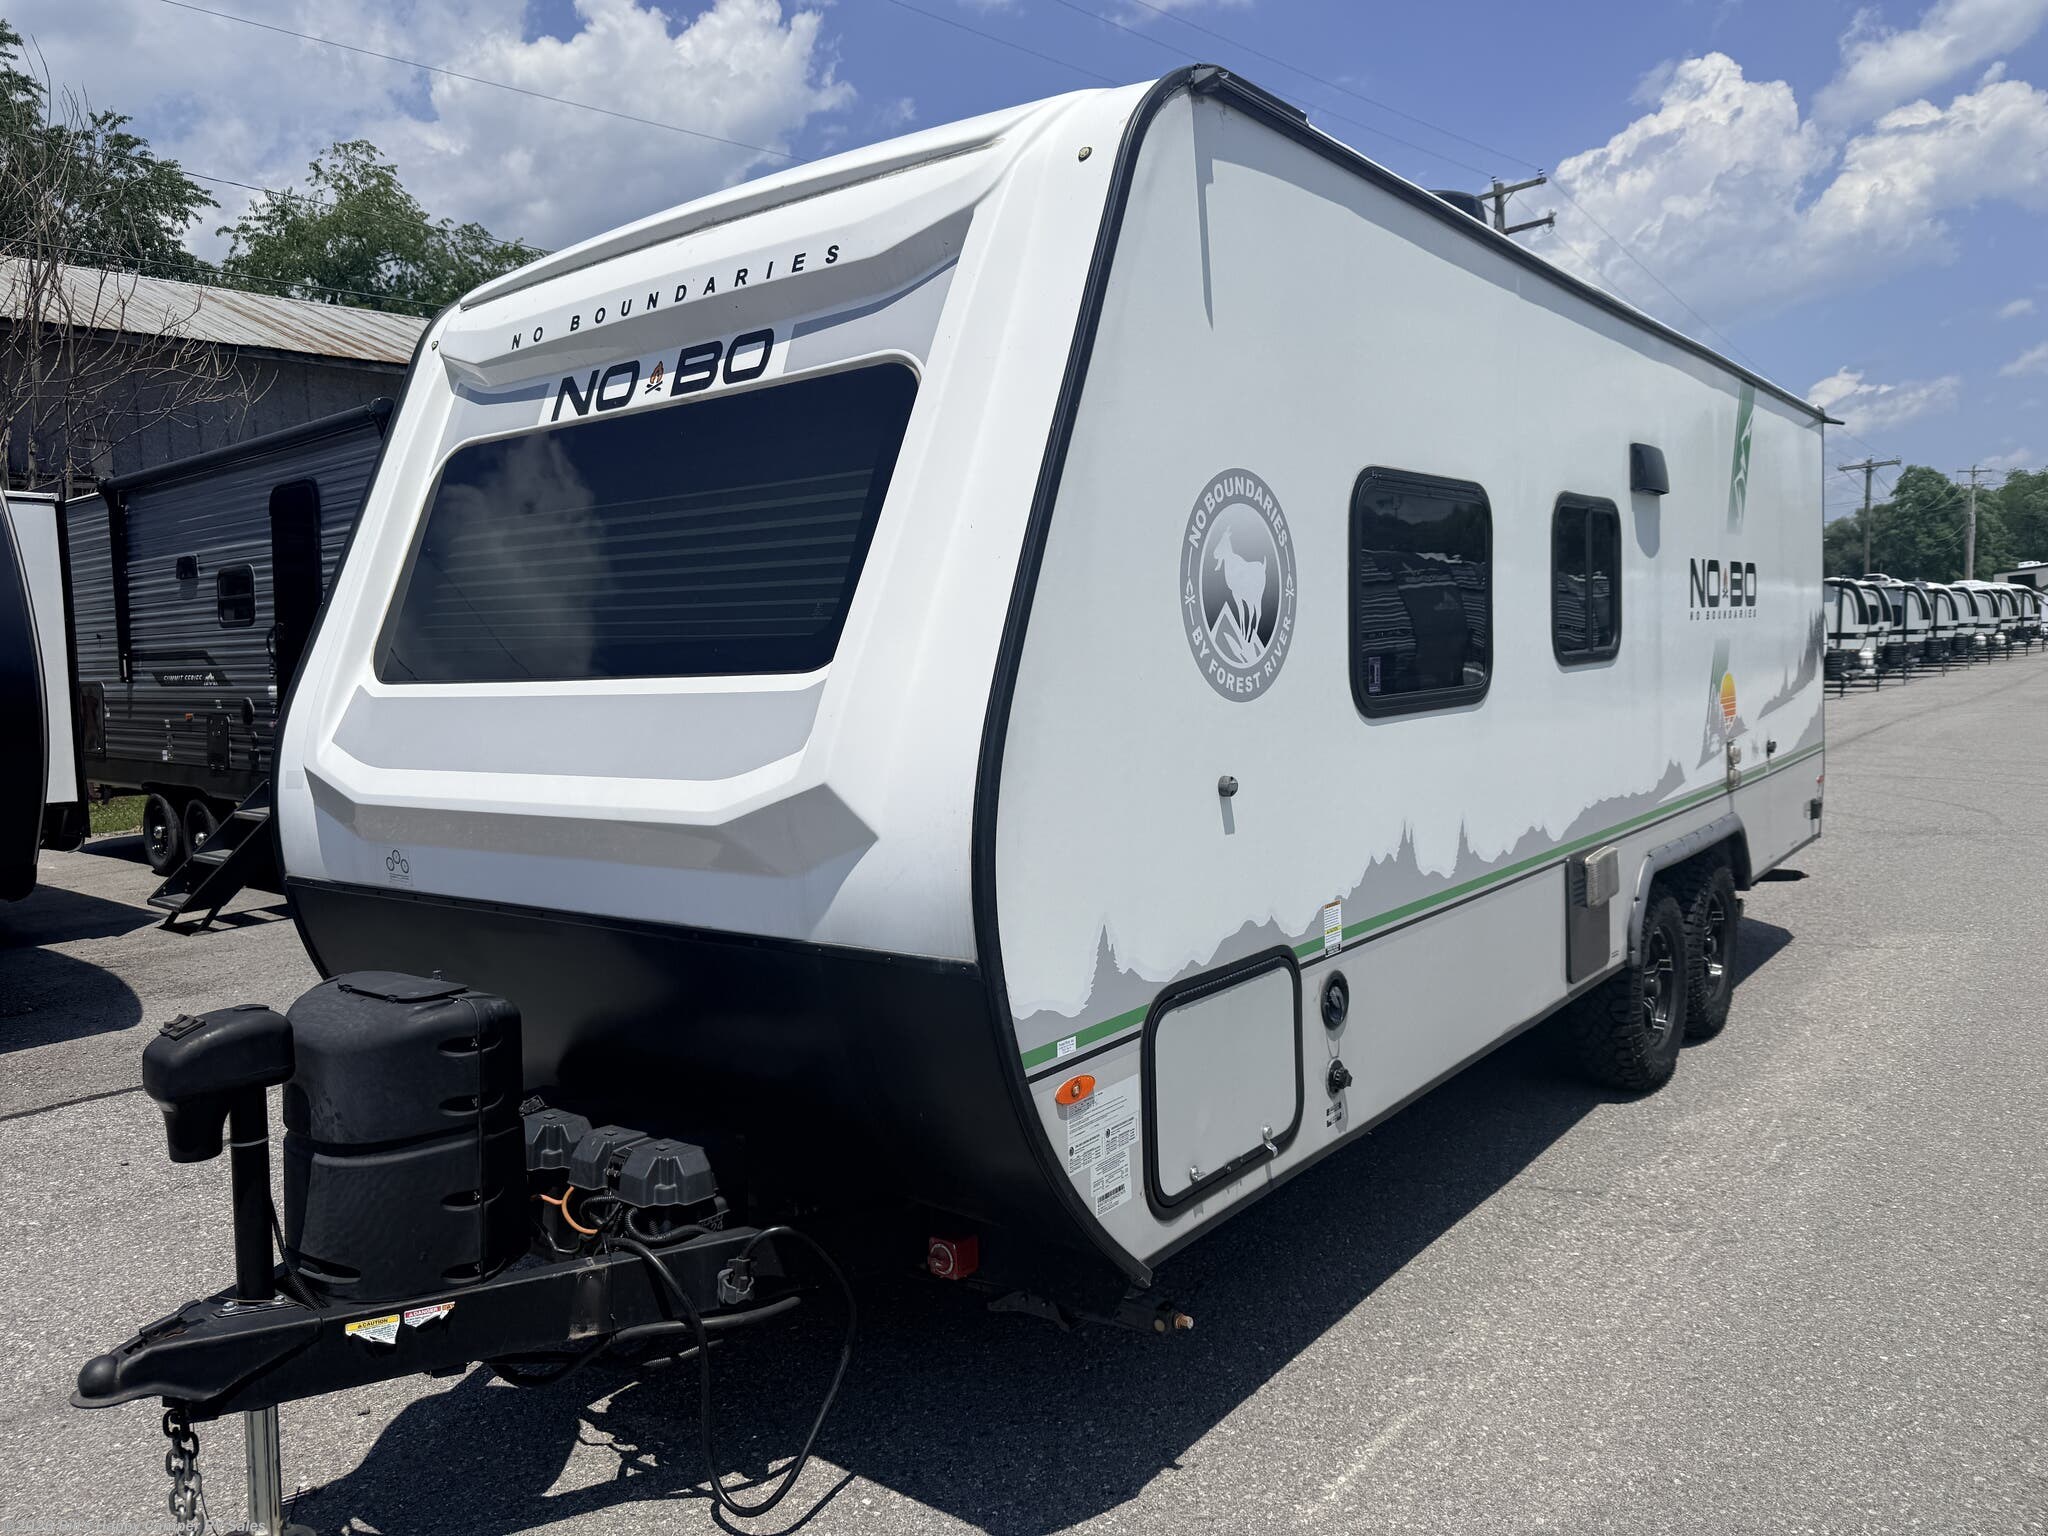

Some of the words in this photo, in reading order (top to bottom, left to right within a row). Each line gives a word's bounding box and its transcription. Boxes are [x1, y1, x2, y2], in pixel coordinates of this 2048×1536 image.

[511, 326, 544, 351] NO
[569, 244, 840, 332] BOUNDARIES
[550, 359, 641, 423] NO
[670, 327, 775, 397] BO
[1188, 510, 1208, 549] NO
[1203, 475, 1289, 548] BOUNDARIES
[1690, 558, 1720, 608] NO
[1730, 561, 1757, 607] BO
[1191, 625, 1211, 659] BY
[1208, 658, 1262, 694] FOREST
[1263, 616, 1292, 678] RIVER
[362, 1318, 389, 1328] CAUTION
